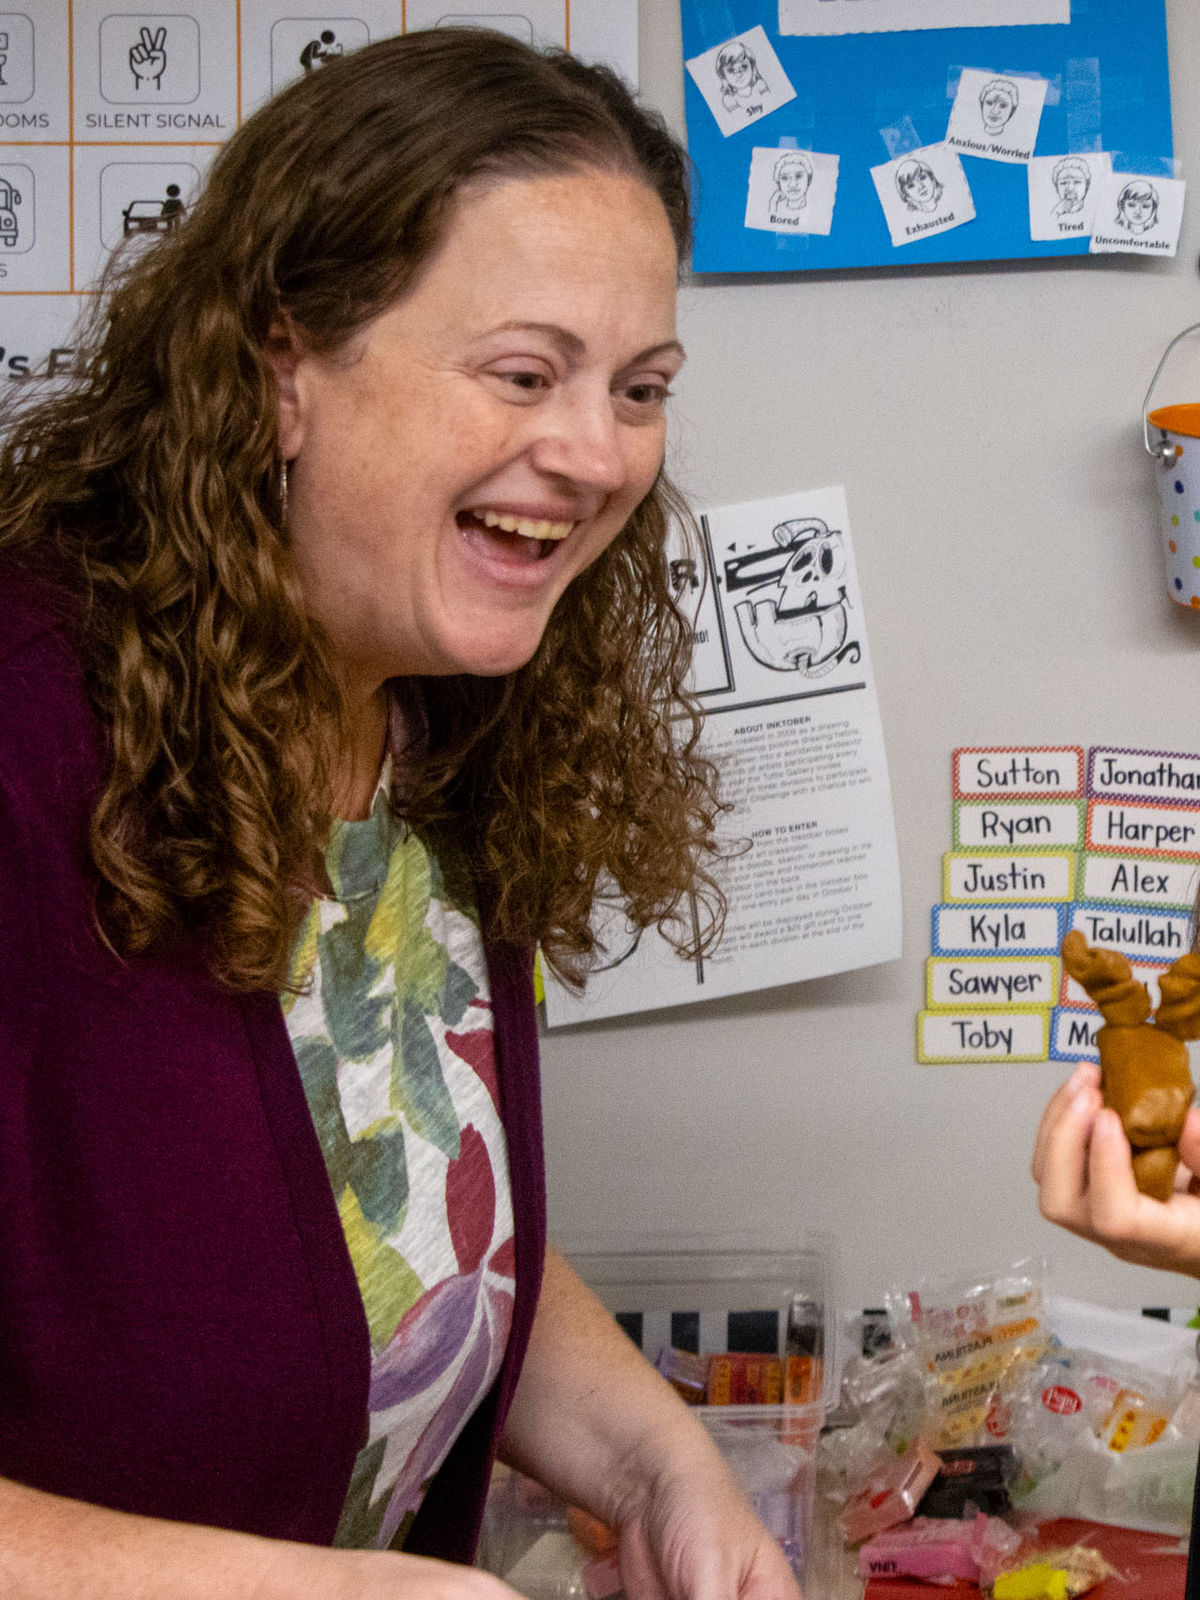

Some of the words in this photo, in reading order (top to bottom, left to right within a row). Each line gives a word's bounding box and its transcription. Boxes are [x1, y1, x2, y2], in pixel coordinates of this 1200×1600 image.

[86, 113, 151, 129] SILENT
[156, 113, 226, 129] SIGNAL
[746, 103, 763, 117] Shy
[948, 136, 1031, 160] Anxious/Worried
[770, 214, 800, 226] Bored
[905, 211, 955, 236] Exhausted
[1058, 221, 1084, 232] Tired
[1095, 235, 1171, 250] Uncomfortable
[734, 725, 764, 736] ABOUT
[766, 715, 812, 730] INKTOBER
[977, 758, 1060, 788] Sutton
[752, 830, 772, 839] HOW
[775, 826, 788, 835] TO
[789, 821, 818, 832] ENTER
[981, 811, 1052, 844] Ryan
[1107, 810, 1196, 848] Harper
[964, 862, 1046, 893] Justin
[1111, 863, 1169, 894] Alex
[970, 913, 1026, 948] Kyla
[1086, 916, 1182, 948] Talullah
[949, 968, 1042, 1001] Sawyer
[951, 1020, 1013, 1054] Toby
